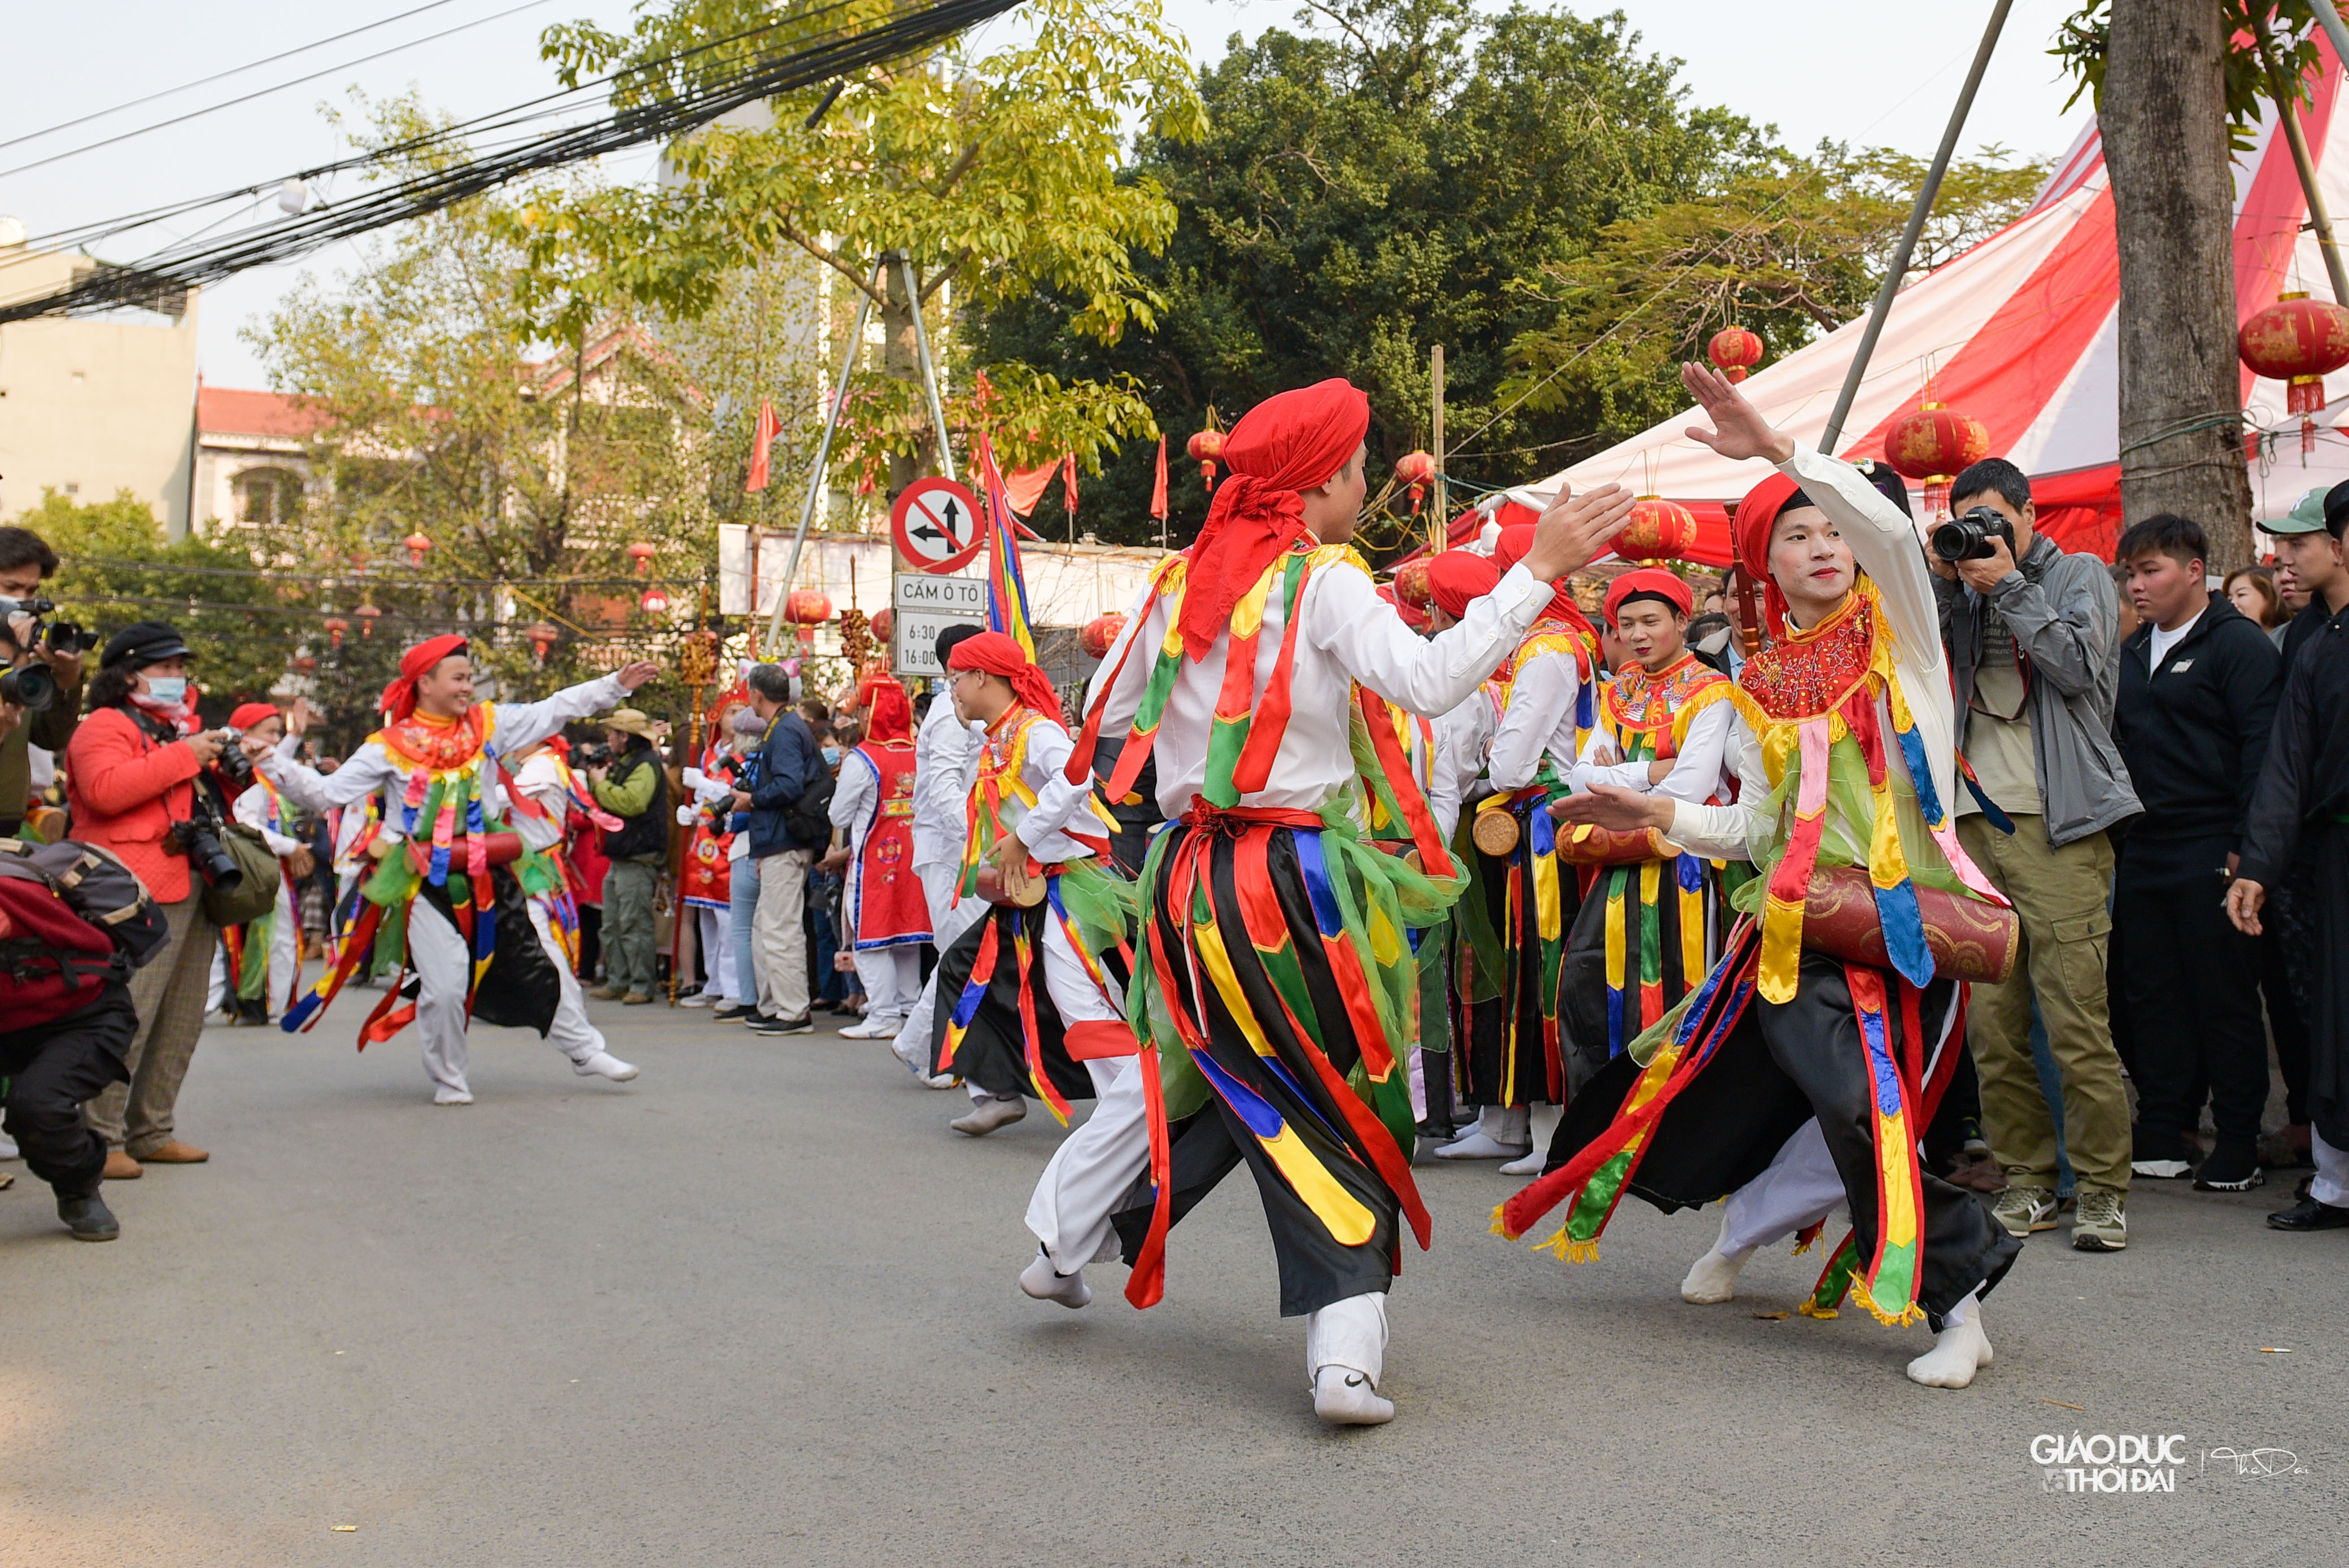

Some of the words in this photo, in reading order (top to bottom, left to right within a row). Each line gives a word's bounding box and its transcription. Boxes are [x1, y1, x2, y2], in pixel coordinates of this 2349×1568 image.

[903, 578, 938, 600] CẤM
[944, 582, 954, 600] Ô
[958, 583, 978, 601] TÔ
[910, 624, 935, 640] 6:30
[905, 649, 935, 665] 16:00
